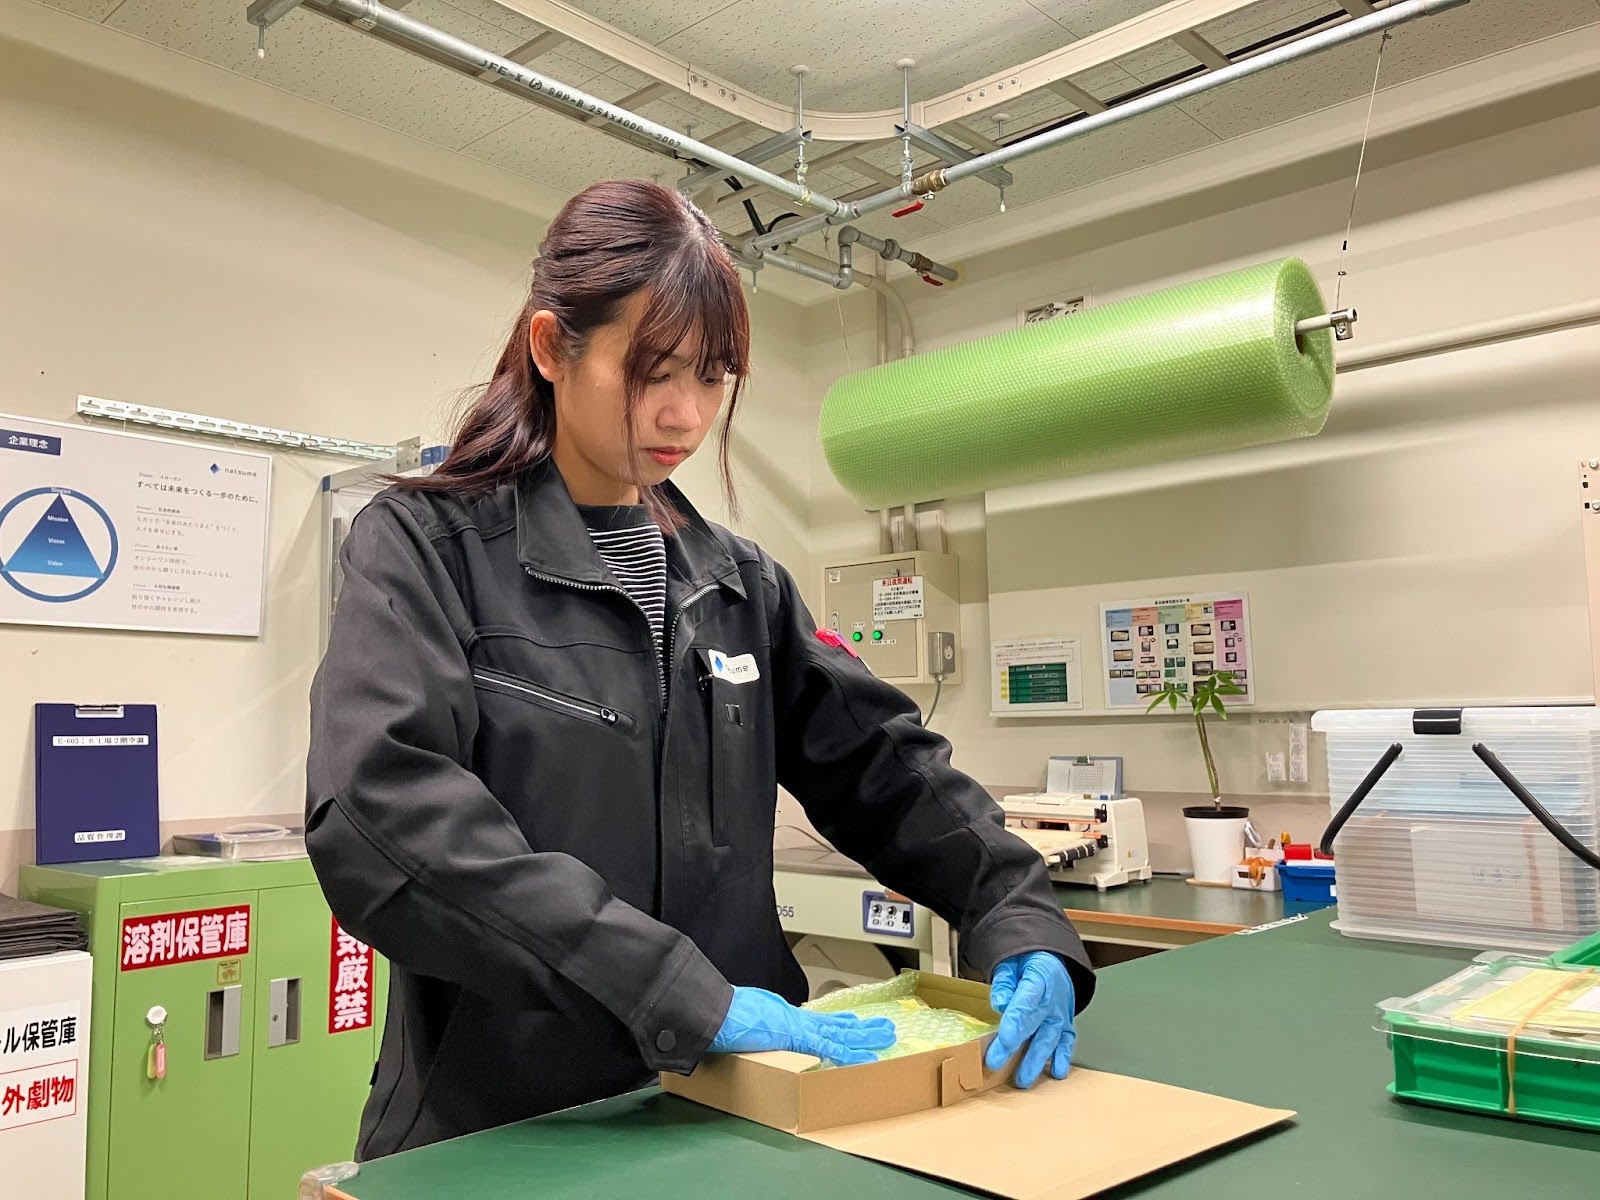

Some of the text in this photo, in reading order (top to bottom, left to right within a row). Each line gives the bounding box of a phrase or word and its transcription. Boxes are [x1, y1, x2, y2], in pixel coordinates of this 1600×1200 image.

[7, 435, 49, 450] 企業理念
[47, 515, 69, 524] Mission
[48, 537, 66, 546] Vision
[47, 560, 64, 568] Value
[123, 910, 248, 966] 溶剤保管庫
[0, 1016, 77, 1054] ル保管庫
[2, 1075, 75, 1116] 外劇物
